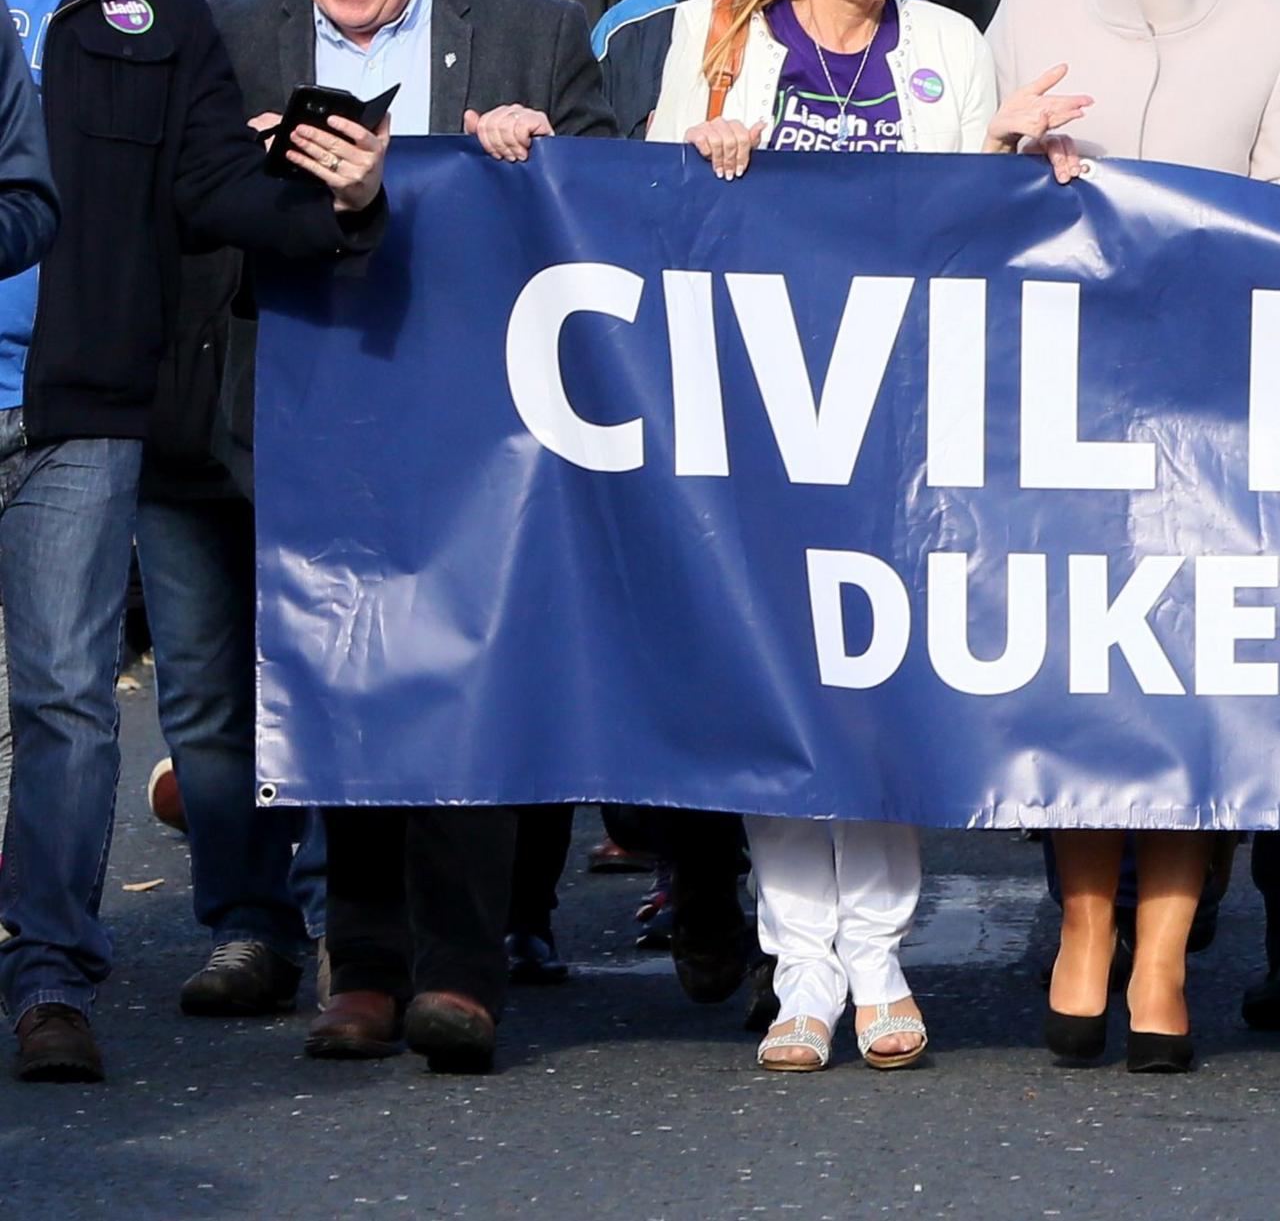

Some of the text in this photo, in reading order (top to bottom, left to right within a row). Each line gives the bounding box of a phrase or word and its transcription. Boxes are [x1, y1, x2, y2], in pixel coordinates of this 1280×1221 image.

[103, 0, 147, 16] Liadh
[784, 95, 868, 137] Liadh
[505, 261, 1157, 491] CIVIL
[806, 547, 1280, 697] DUKE
